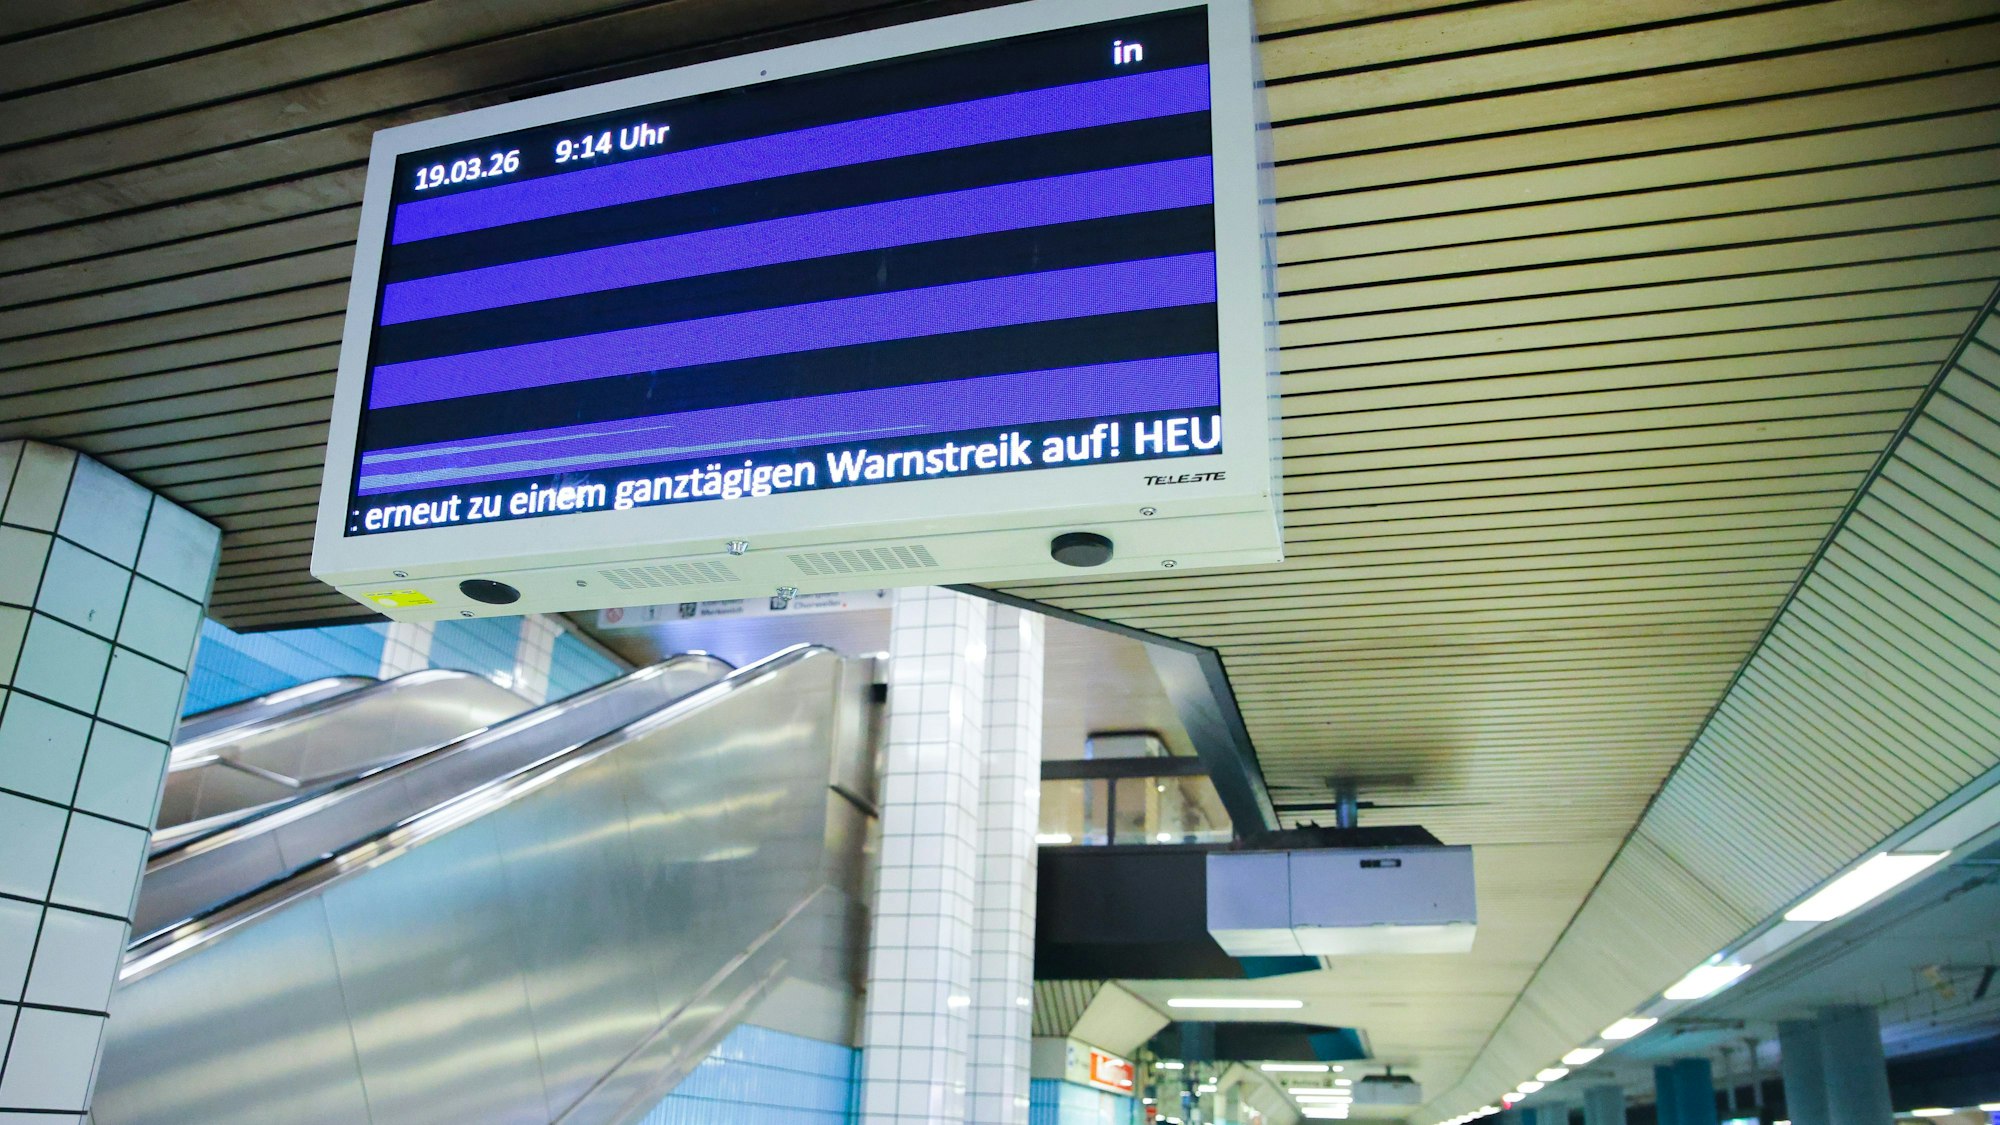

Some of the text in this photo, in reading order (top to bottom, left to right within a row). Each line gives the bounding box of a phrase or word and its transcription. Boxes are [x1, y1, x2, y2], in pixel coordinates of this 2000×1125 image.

[1112, 39, 1144, 66] in
[414, 121, 671, 192] 19.03.26 9:14 Uhr
[363, 494, 462, 531] erneut
[466, 494, 503, 521] zu
[509, 481, 606, 516] einem
[614, 459, 816, 512] ganztägigen
[825, 432, 1033, 485] Warnstreik
[1042, 421, 1121, 464] auf!
[1134, 413, 1221, 456] HEU
[1144, 471, 1226, 486] TELESTE
